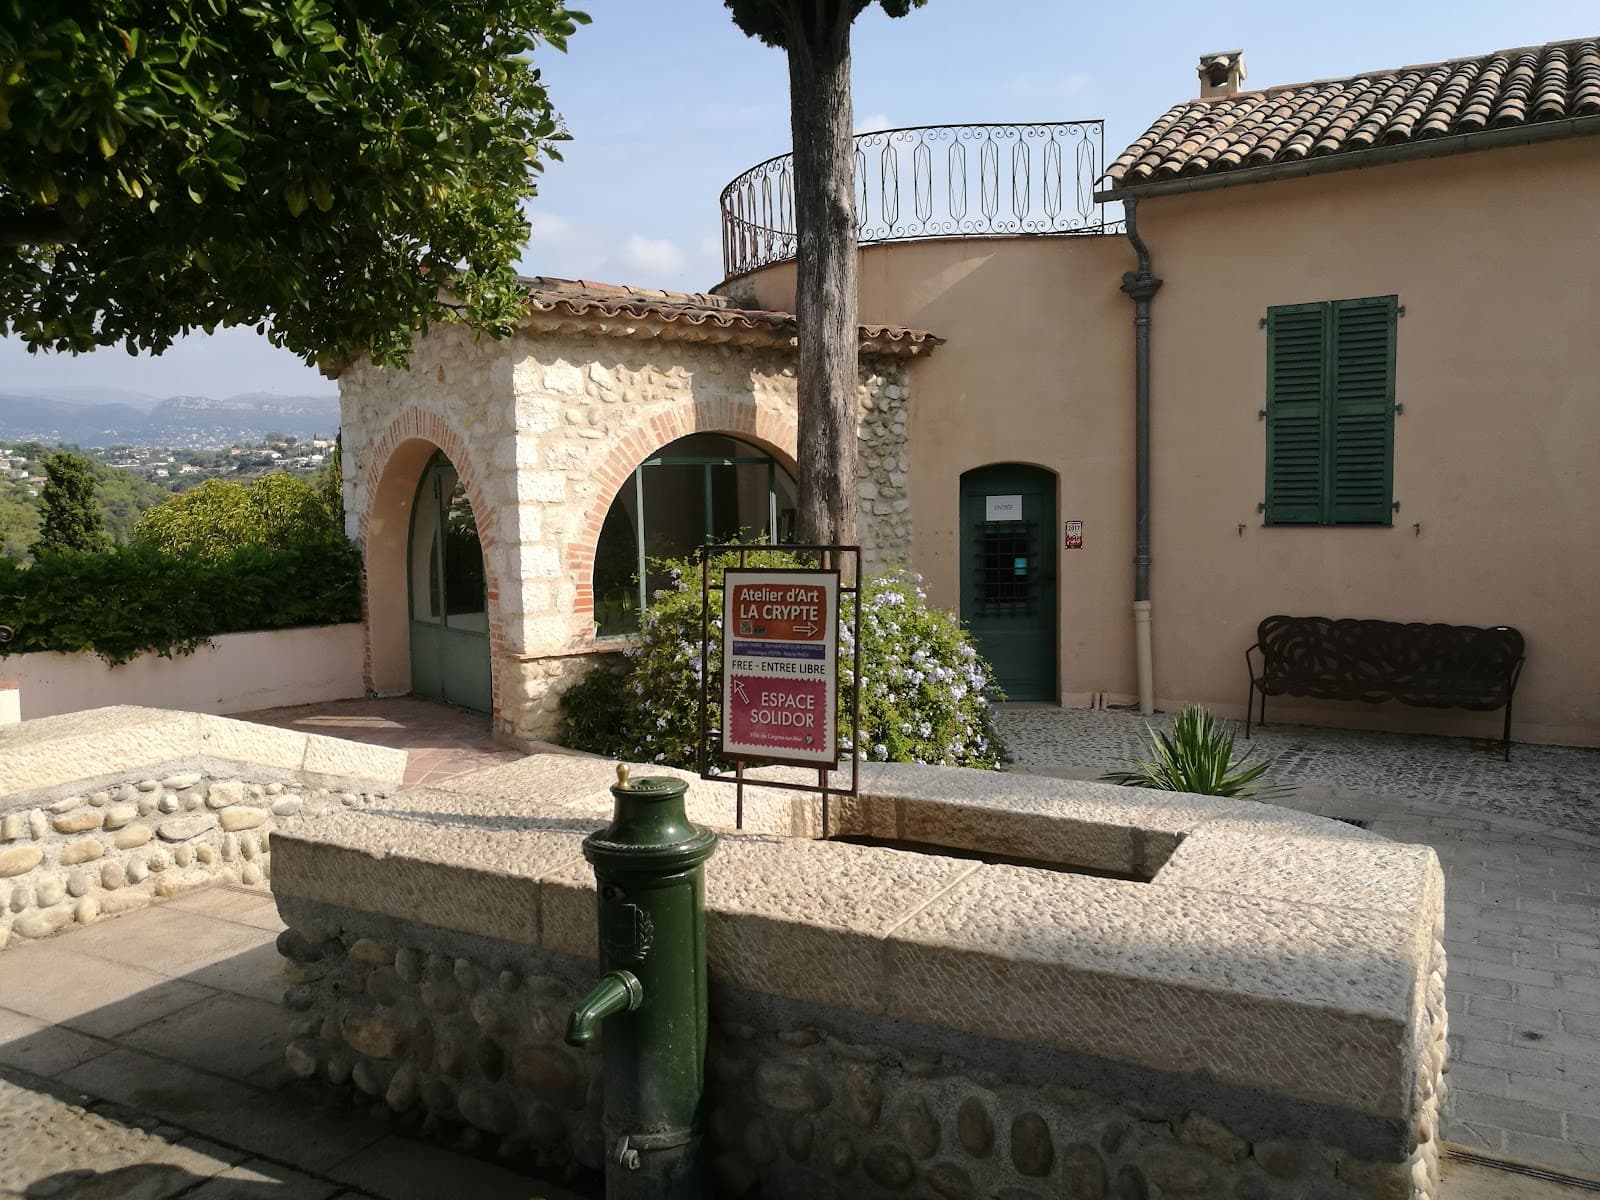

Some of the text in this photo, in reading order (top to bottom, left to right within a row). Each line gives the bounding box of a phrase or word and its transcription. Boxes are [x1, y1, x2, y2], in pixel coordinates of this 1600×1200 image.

[740, 588, 819, 602] Atelier d'Art
[740, 605, 819, 621] LA CRYPTE
[732, 660, 753, 671] FREE
[761, 662, 797, 673] ENTREE
[799, 664, 826, 675] LIBRE
[761, 692, 815, 710] ESPACE
[750, 709, 814, 728] SOLIDOR
